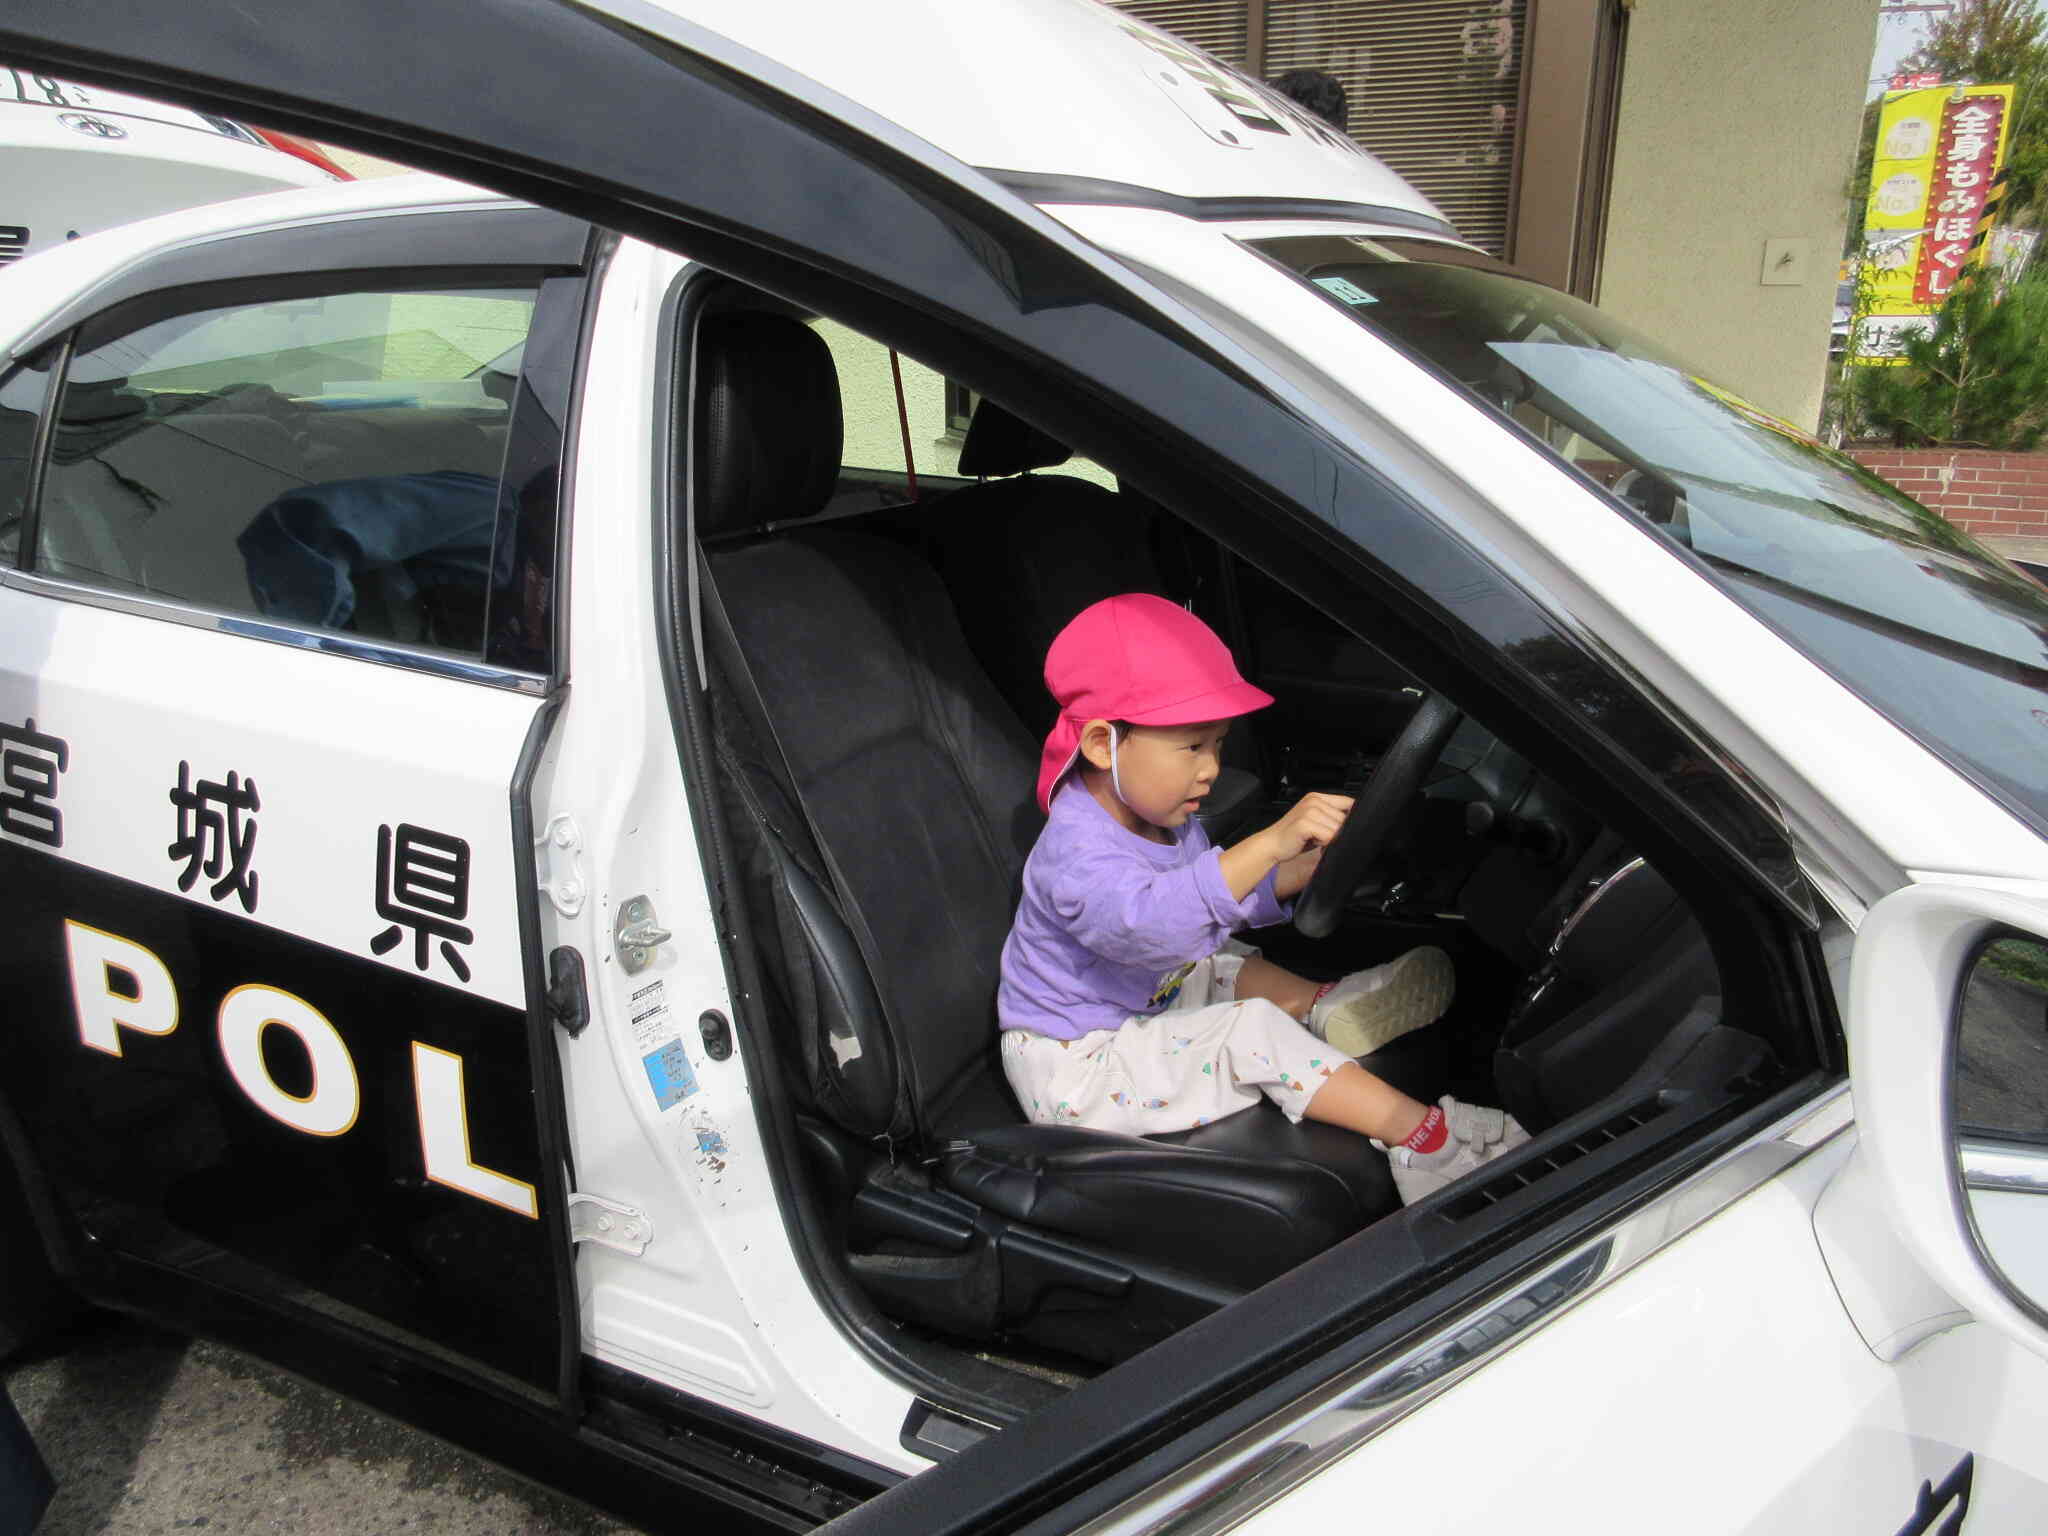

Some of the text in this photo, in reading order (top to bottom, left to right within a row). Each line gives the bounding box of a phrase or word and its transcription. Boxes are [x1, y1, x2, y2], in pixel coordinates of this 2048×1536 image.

[1928, 104, 1993, 296] 全身もみほぐし
[0, 718, 474, 984] 宮城県
[64, 917, 539, 1221] POL
